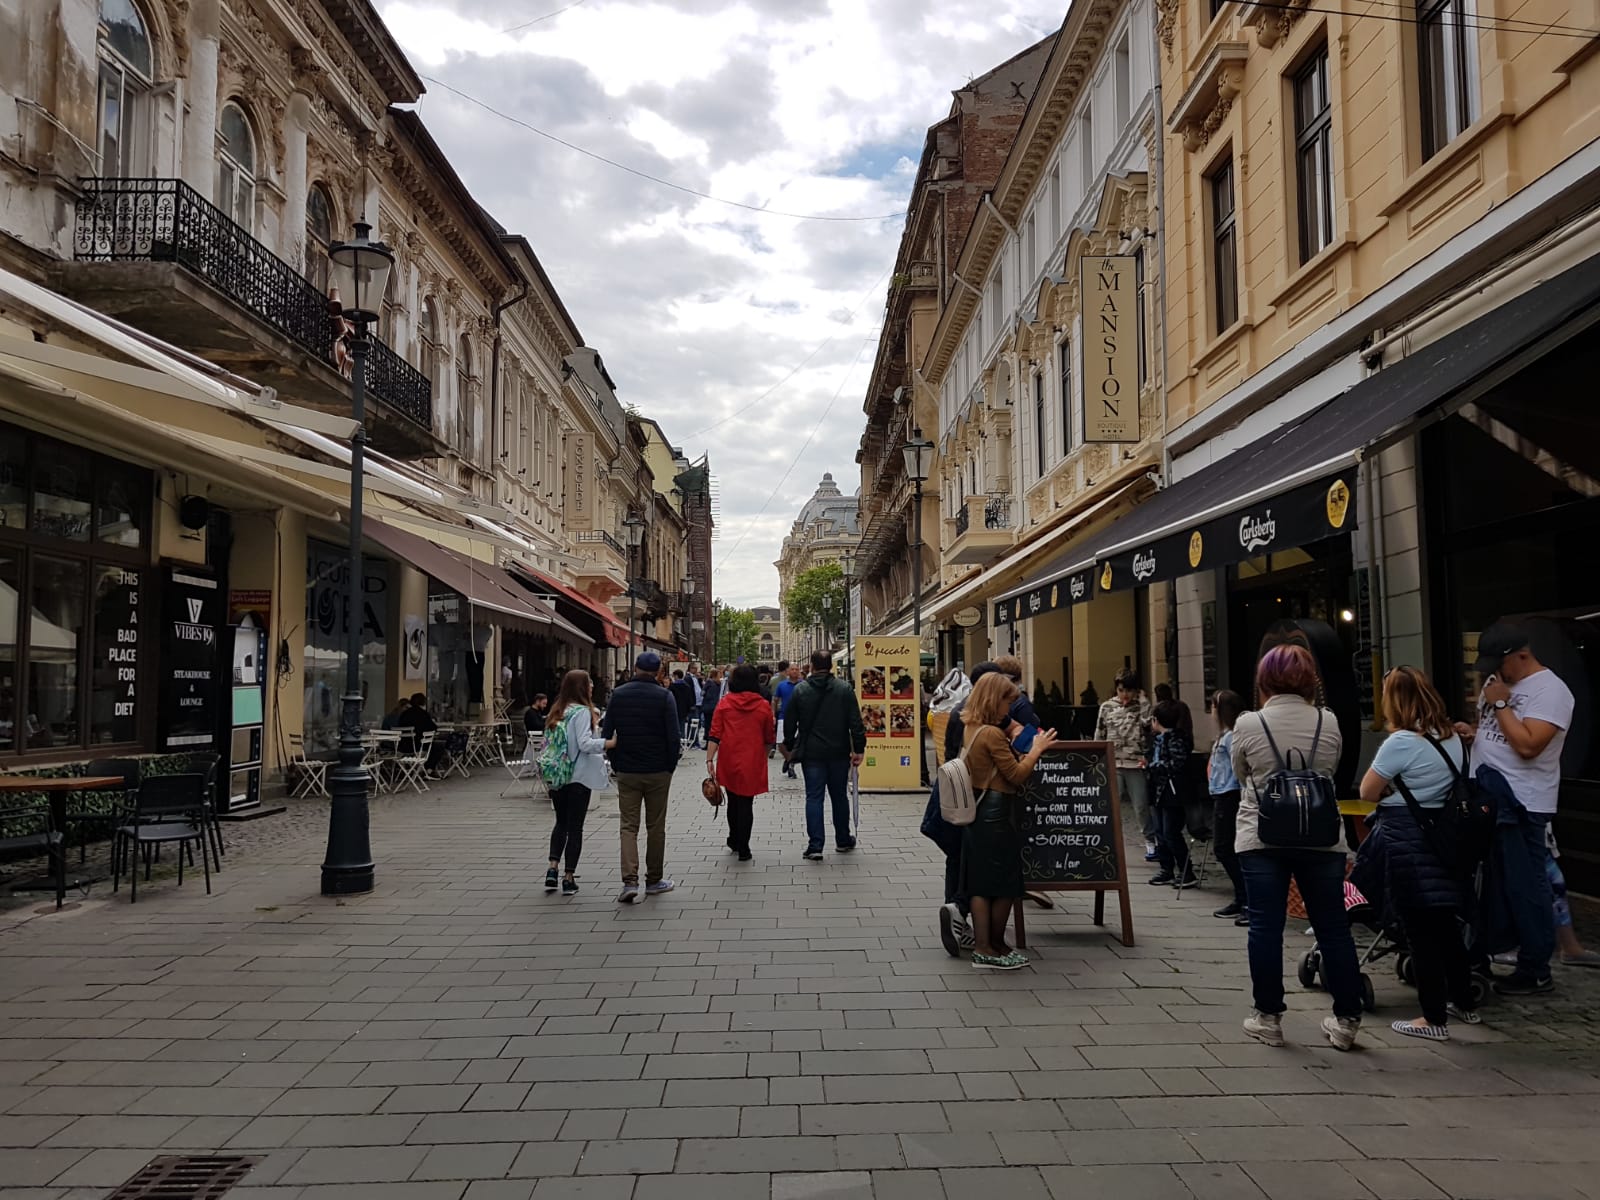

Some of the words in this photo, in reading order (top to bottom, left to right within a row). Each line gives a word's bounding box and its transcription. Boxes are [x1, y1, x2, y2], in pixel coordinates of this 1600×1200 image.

[1100, 259, 1115, 271] the
[1097, 272, 1120, 417] MANSION
[575, 438, 585, 512] CONCORDE
[1239, 510, 1276, 551] Carlsberg
[119, 571, 138, 585] THIS
[129, 591, 137, 604] IS
[130, 610, 137, 623] A
[117, 629, 137, 643] BAD
[174, 624, 202, 641] VIBES
[202, 627, 213, 646] 19
[109, 648, 136, 662] PLACE
[874, 645, 910, 659] peccato
[118, 668, 136, 681] FOR
[173, 669, 211, 680] STEAKHOUSE
[127, 684, 134, 696] A
[180, 697, 204, 706] LOUNGE
[115, 702, 134, 716] DIET
[1034, 759, 1069, 770] ebanese
[1041, 772, 1085, 784] Artisanal
[1056, 786, 1068, 797] ICE
[1071, 786, 1100, 797] CREAM
[1049, 803, 1069, 812] GOAT
[1073, 803, 1093, 813] MILK
[1045, 815, 1072, 825] ORCHID
[1075, 815, 1109, 825] EXTRACT
[1035, 834, 1101, 846] SORBETO
